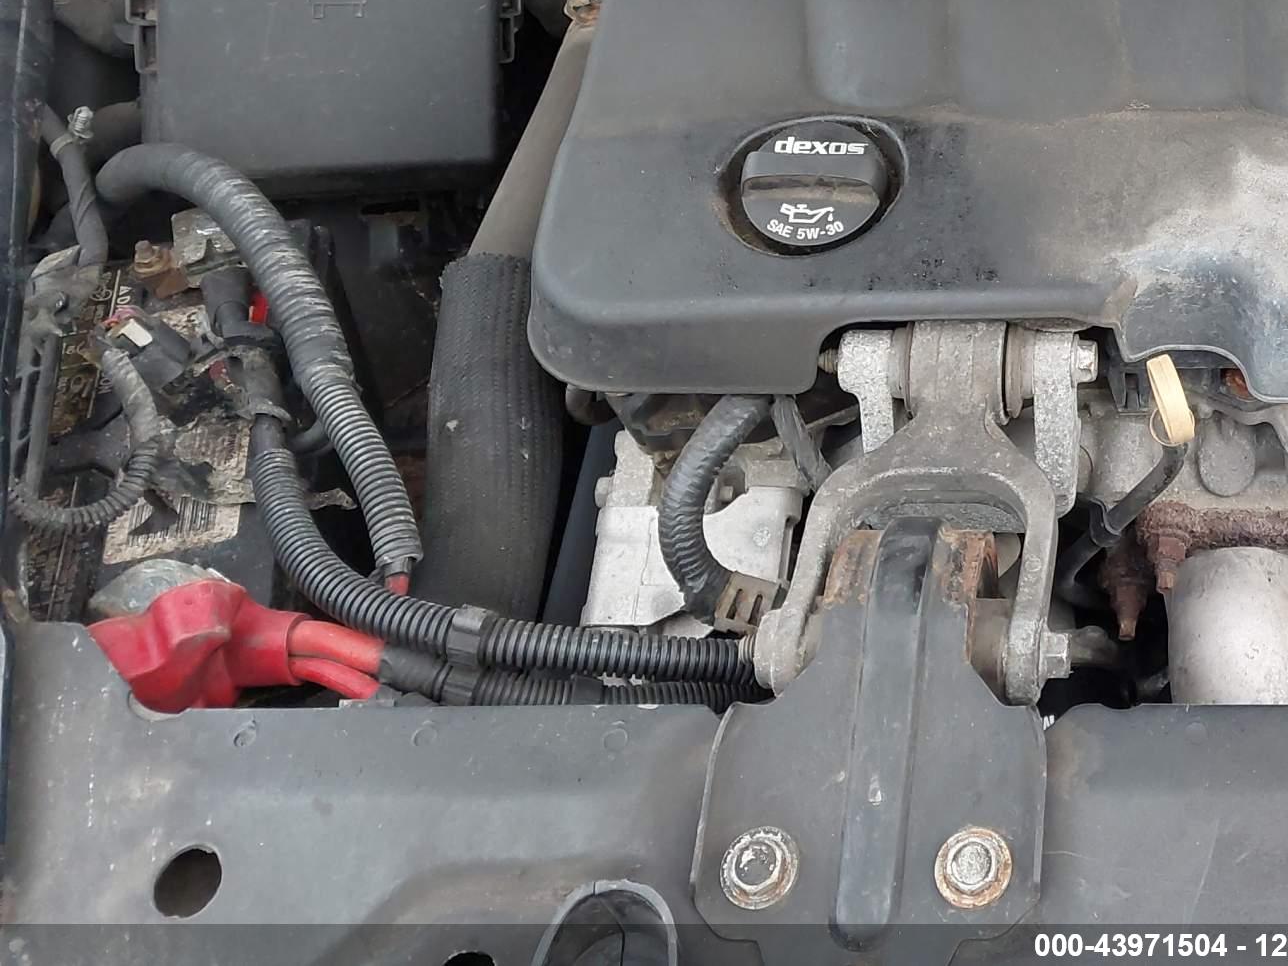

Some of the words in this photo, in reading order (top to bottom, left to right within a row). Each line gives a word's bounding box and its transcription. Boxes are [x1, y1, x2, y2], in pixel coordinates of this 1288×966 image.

[774, 136, 868, 155] dexos
[766, 219, 794, 238] SAE
[796, 220, 845, 241] 5W-30
